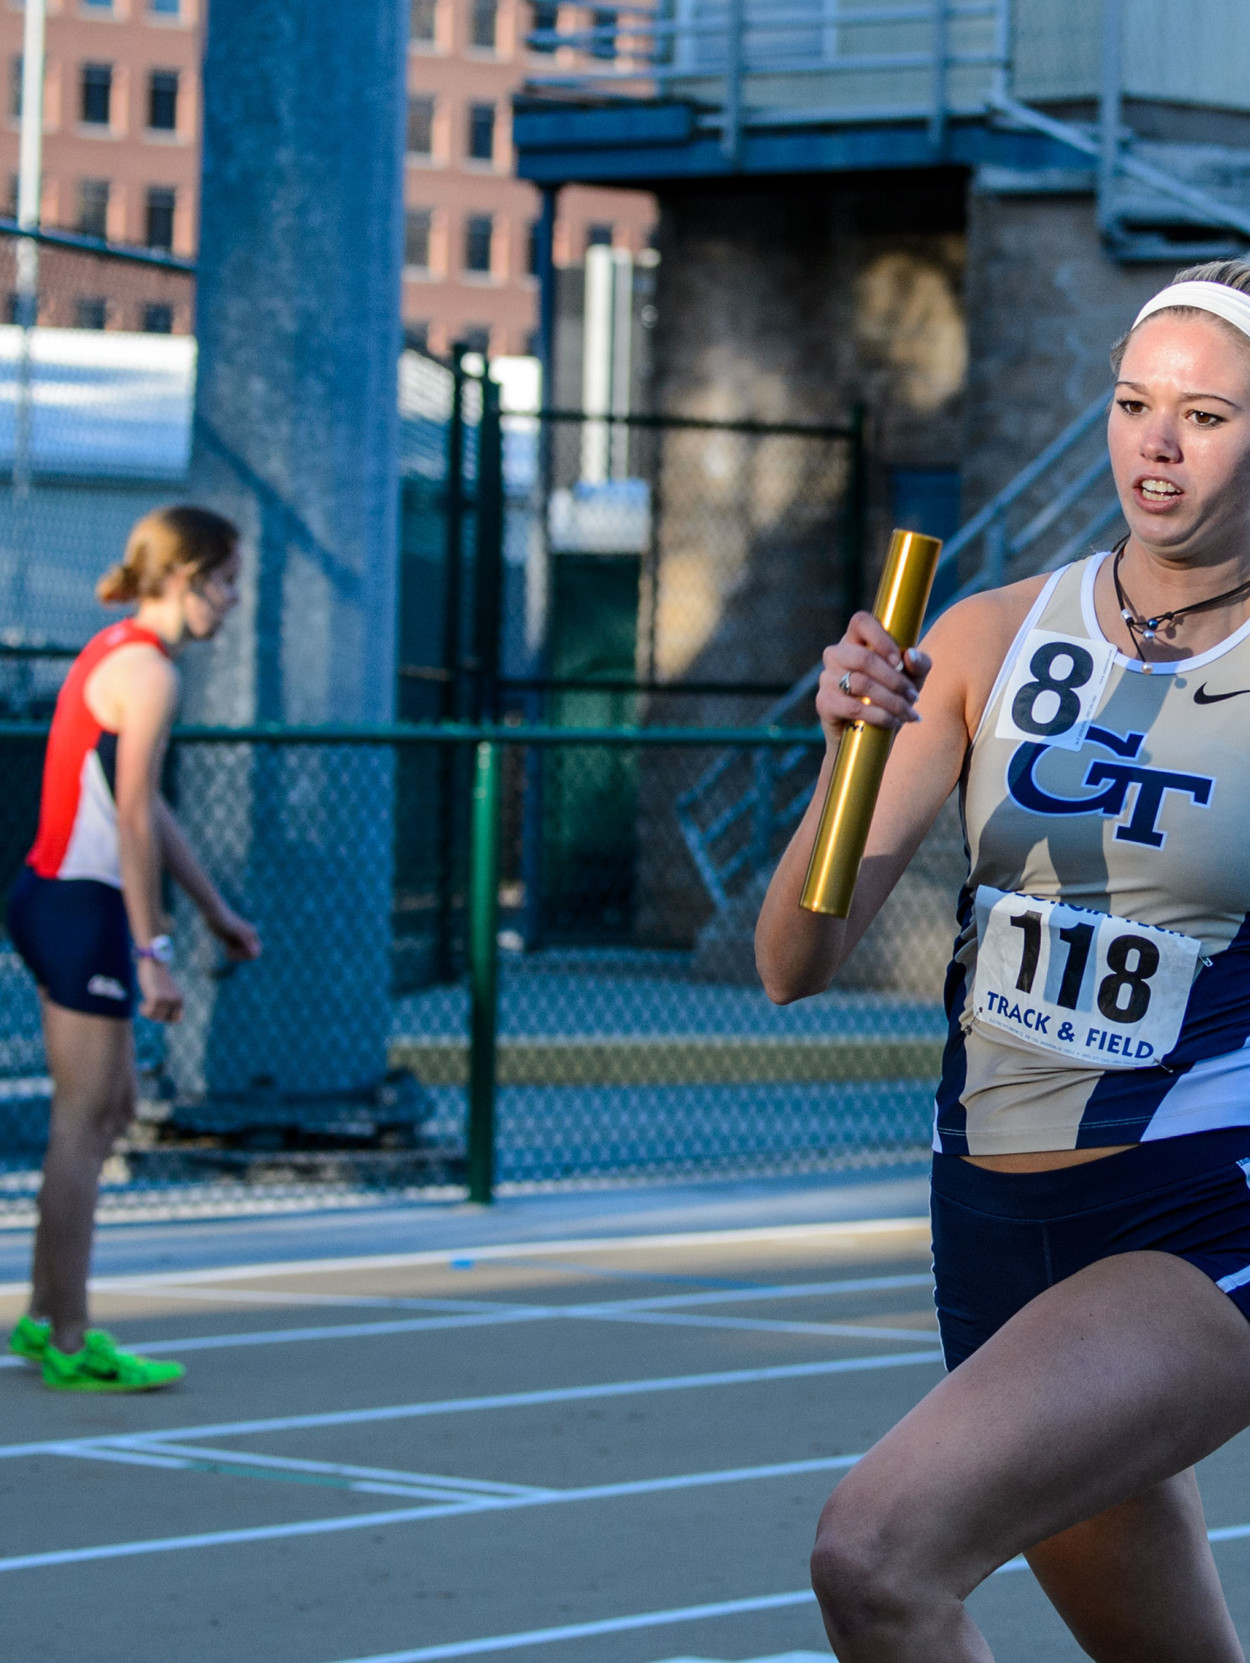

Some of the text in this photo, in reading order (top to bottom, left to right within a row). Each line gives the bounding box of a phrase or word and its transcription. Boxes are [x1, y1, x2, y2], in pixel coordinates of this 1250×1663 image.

[1011, 641, 1094, 737] 8
[1006, 725, 1216, 850] GT
[1010, 910, 1160, 1024] 118
[987, 991, 1051, 1034] TRACK
[1057, 1021, 1075, 1042] &
[1085, 1028, 1154, 1059] FIELD
